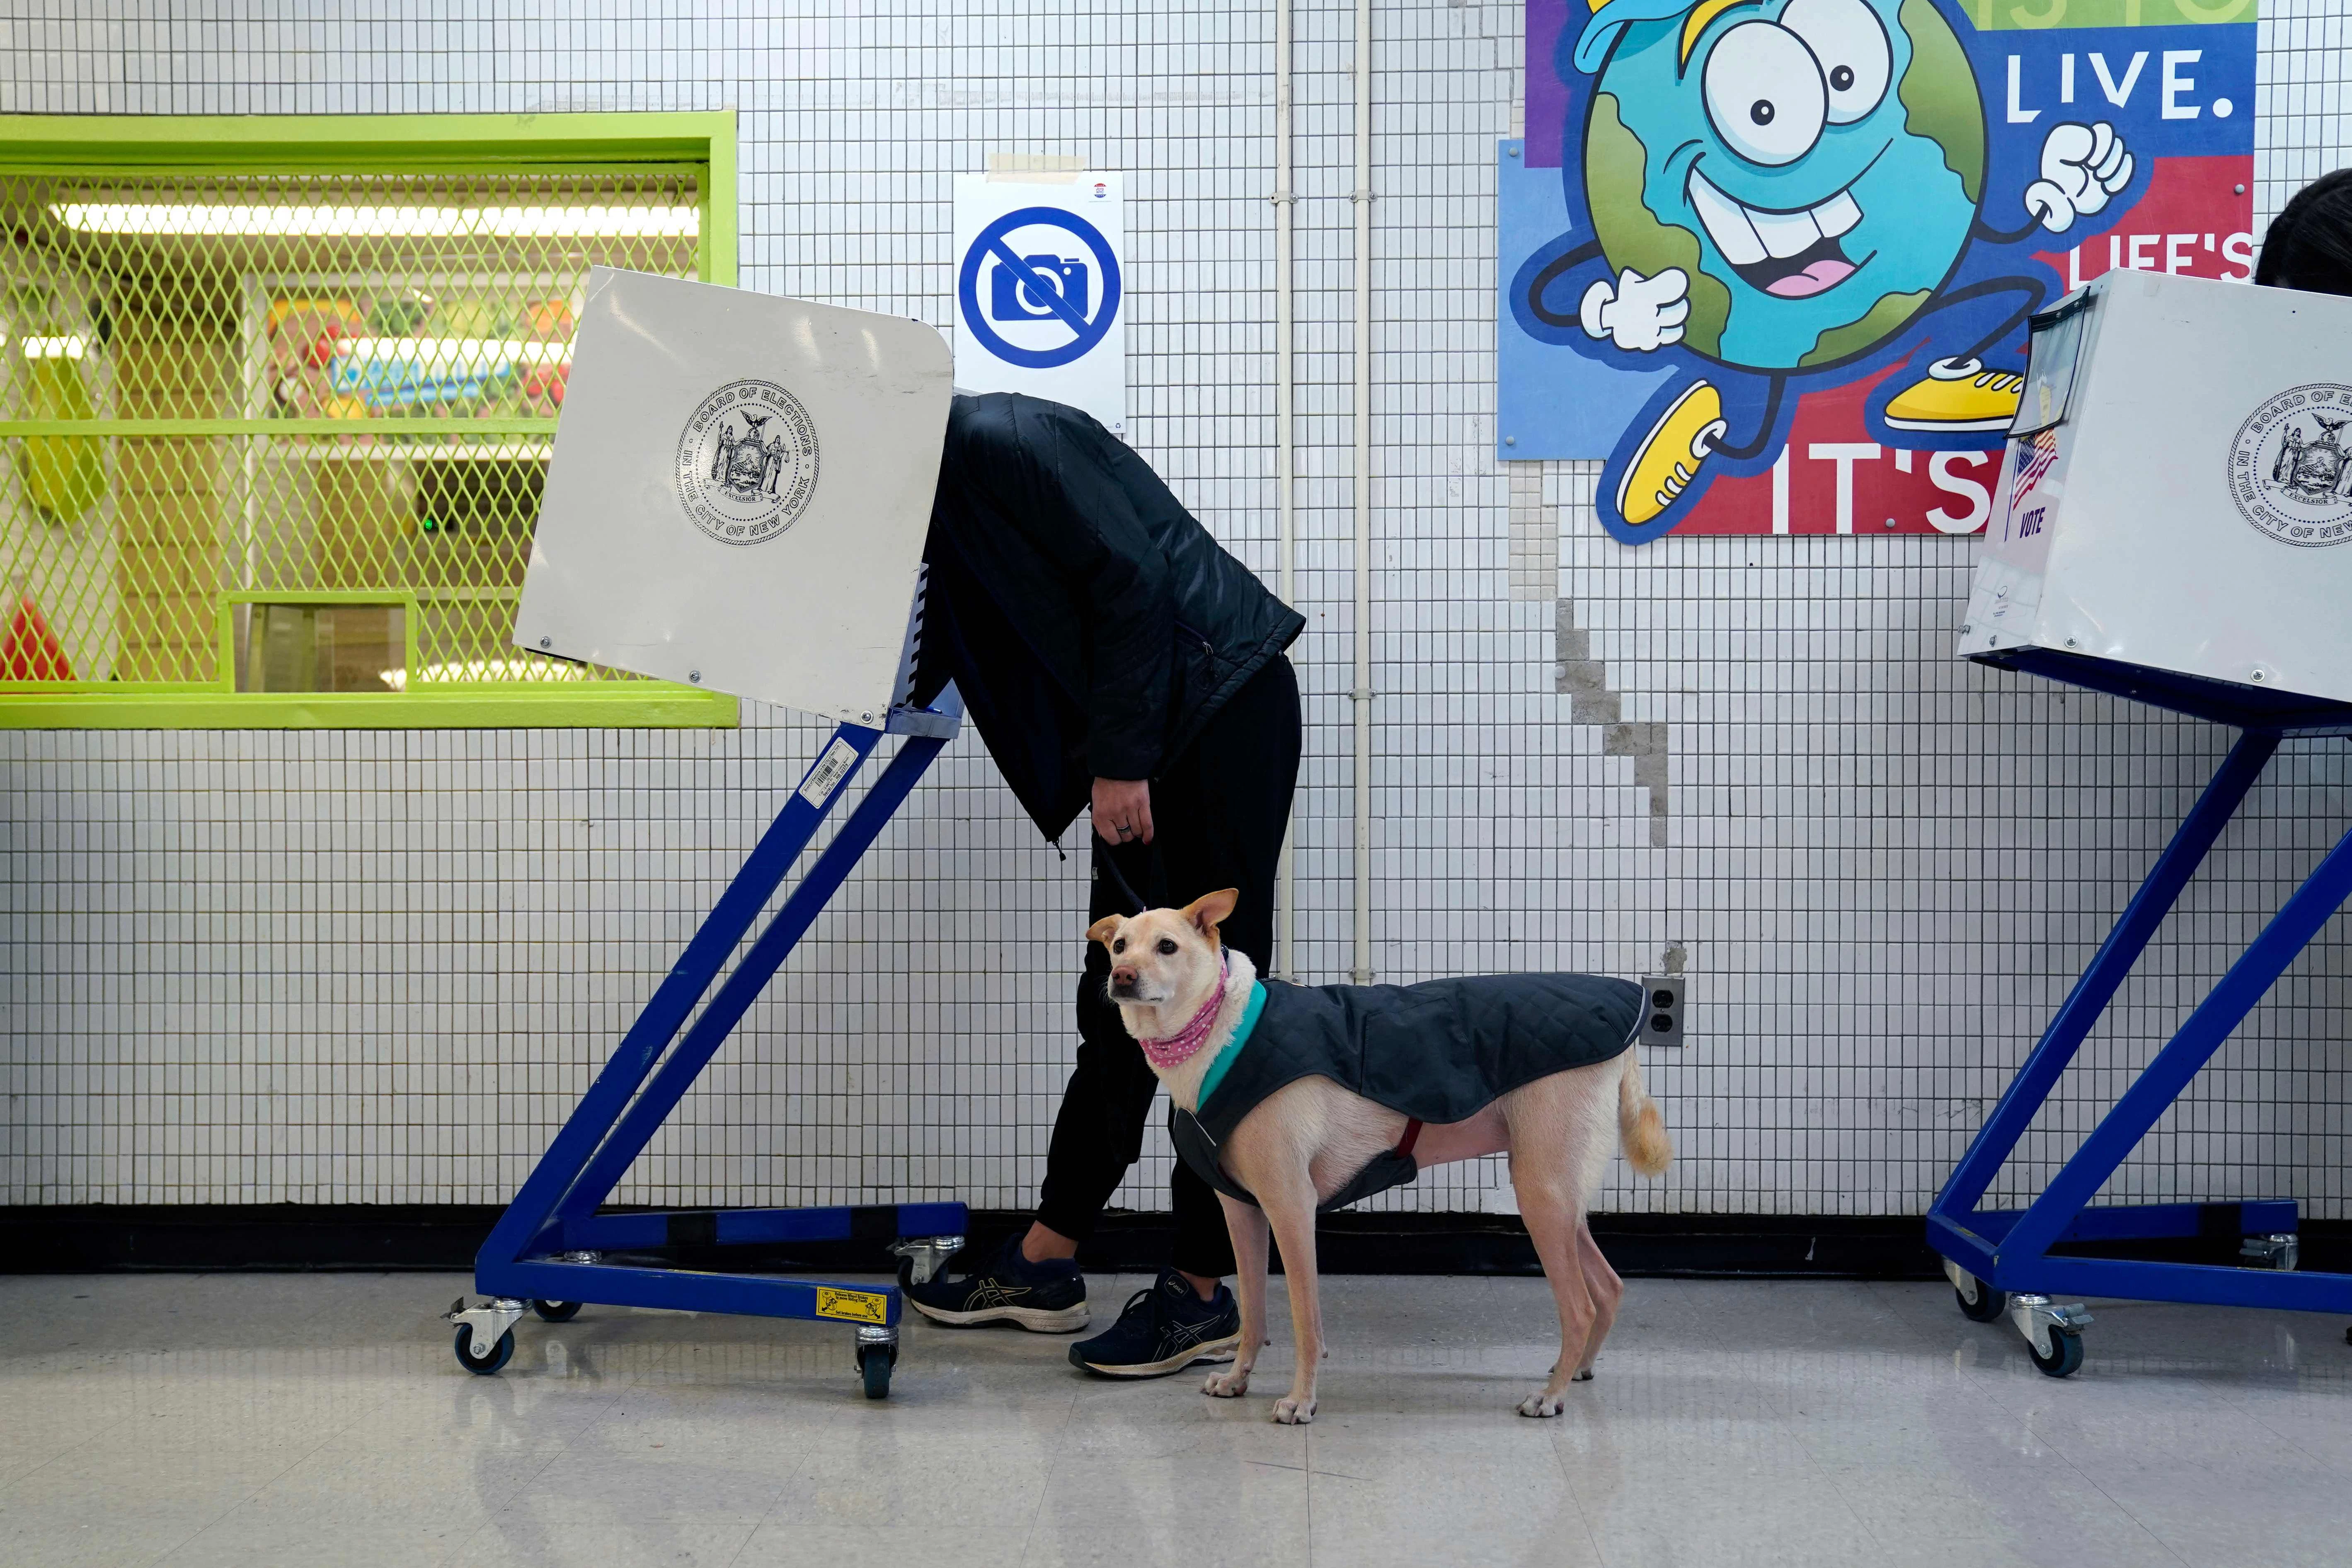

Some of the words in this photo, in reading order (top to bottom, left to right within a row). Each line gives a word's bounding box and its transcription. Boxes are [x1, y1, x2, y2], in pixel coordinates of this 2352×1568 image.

[2007, 49, 2233, 123] LIVE.
[693, 392, 735, 432] BOARD
[739, 388, 757, 399] OF
[761, 390, 812, 457] ELECTIONS
[2251, 395, 2305, 434] BOARD
[2311, 391, 2334, 402] OF
[682, 450, 693, 466] IN
[2237, 451, 2250, 466] IN
[683, 471, 699, 503] THE
[724, 490, 756, 502] EXCELSIOR
[782, 476, 810, 516] YORK
[1773, 443, 1990, 534] IT'S
[2238, 472, 2256, 502] THE
[2289, 492, 2328, 504] EXCELSIOR
[695, 505, 724, 531] CITY
[726, 524, 745, 537] OF
[749, 514, 780, 536] NEW
[2020, 507, 2046, 538] VOTE
[2253, 505, 2288, 532] CITY
[2291, 526, 2314, 538] OF
[823, 785, 831, 797] Serial
[1173, 1284, 1184, 1294] asics
